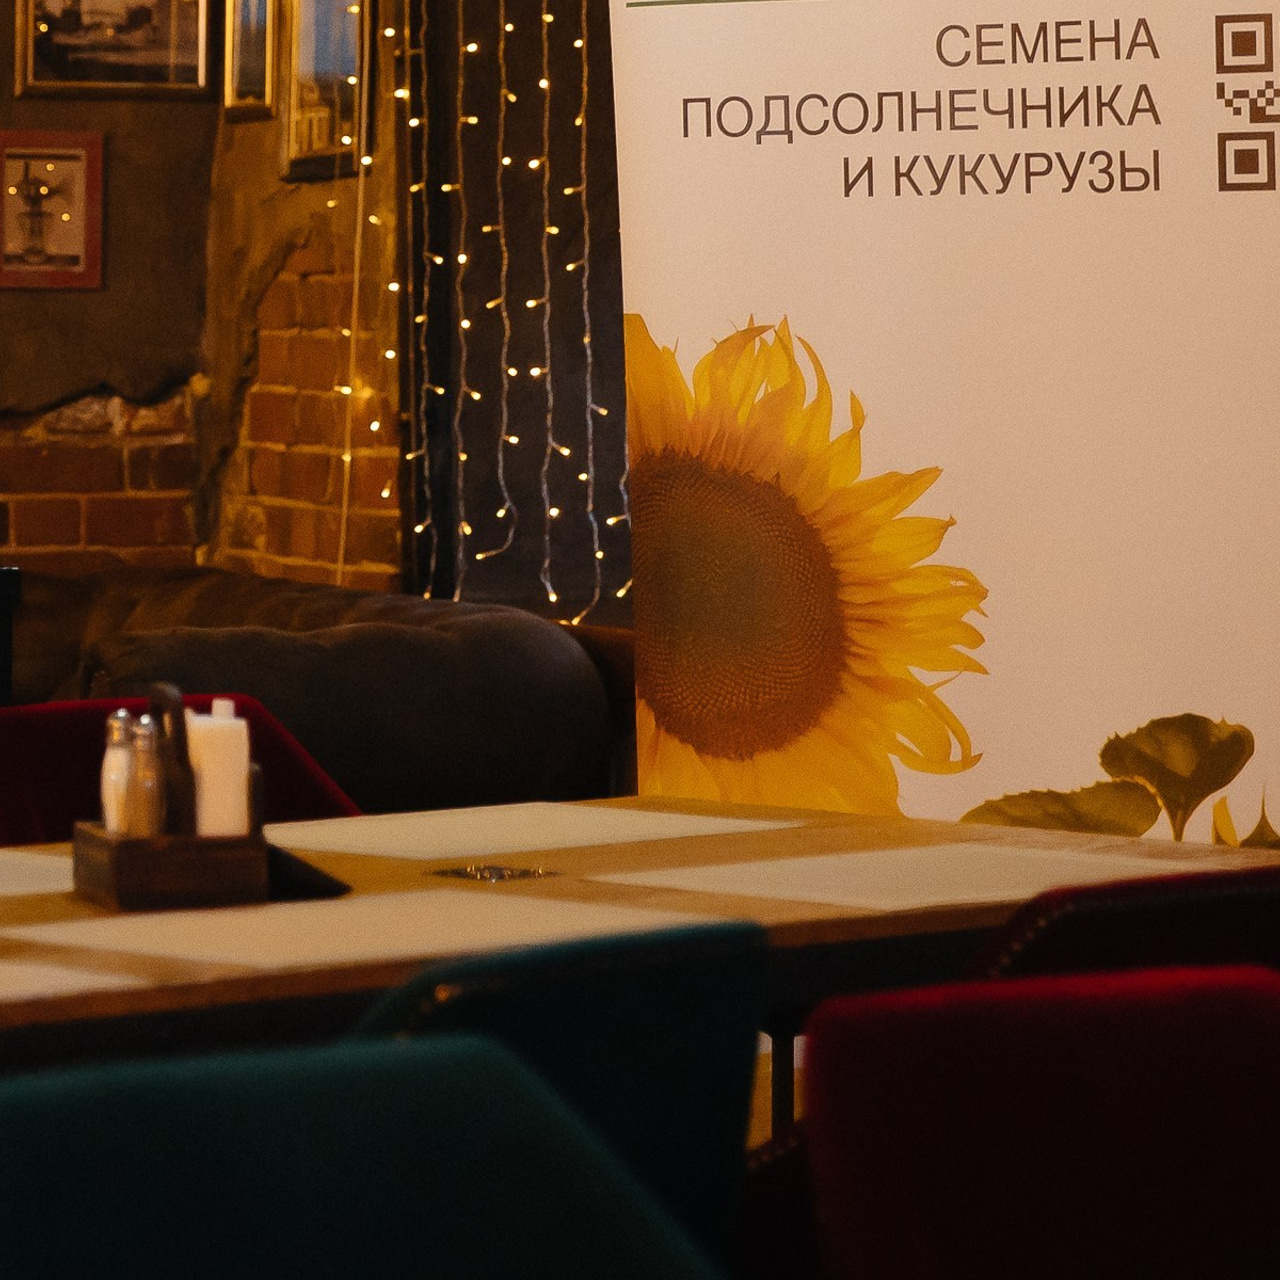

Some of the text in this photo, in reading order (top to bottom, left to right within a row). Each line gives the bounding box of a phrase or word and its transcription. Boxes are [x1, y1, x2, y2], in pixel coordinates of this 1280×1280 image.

[936, 18, 1160, 67] СЕМЕНА
[683, 84, 1161, 145] ПОДСОЛНЕЧНИКА
[844, 150, 1160, 197] И КУКУРУЗЫ
